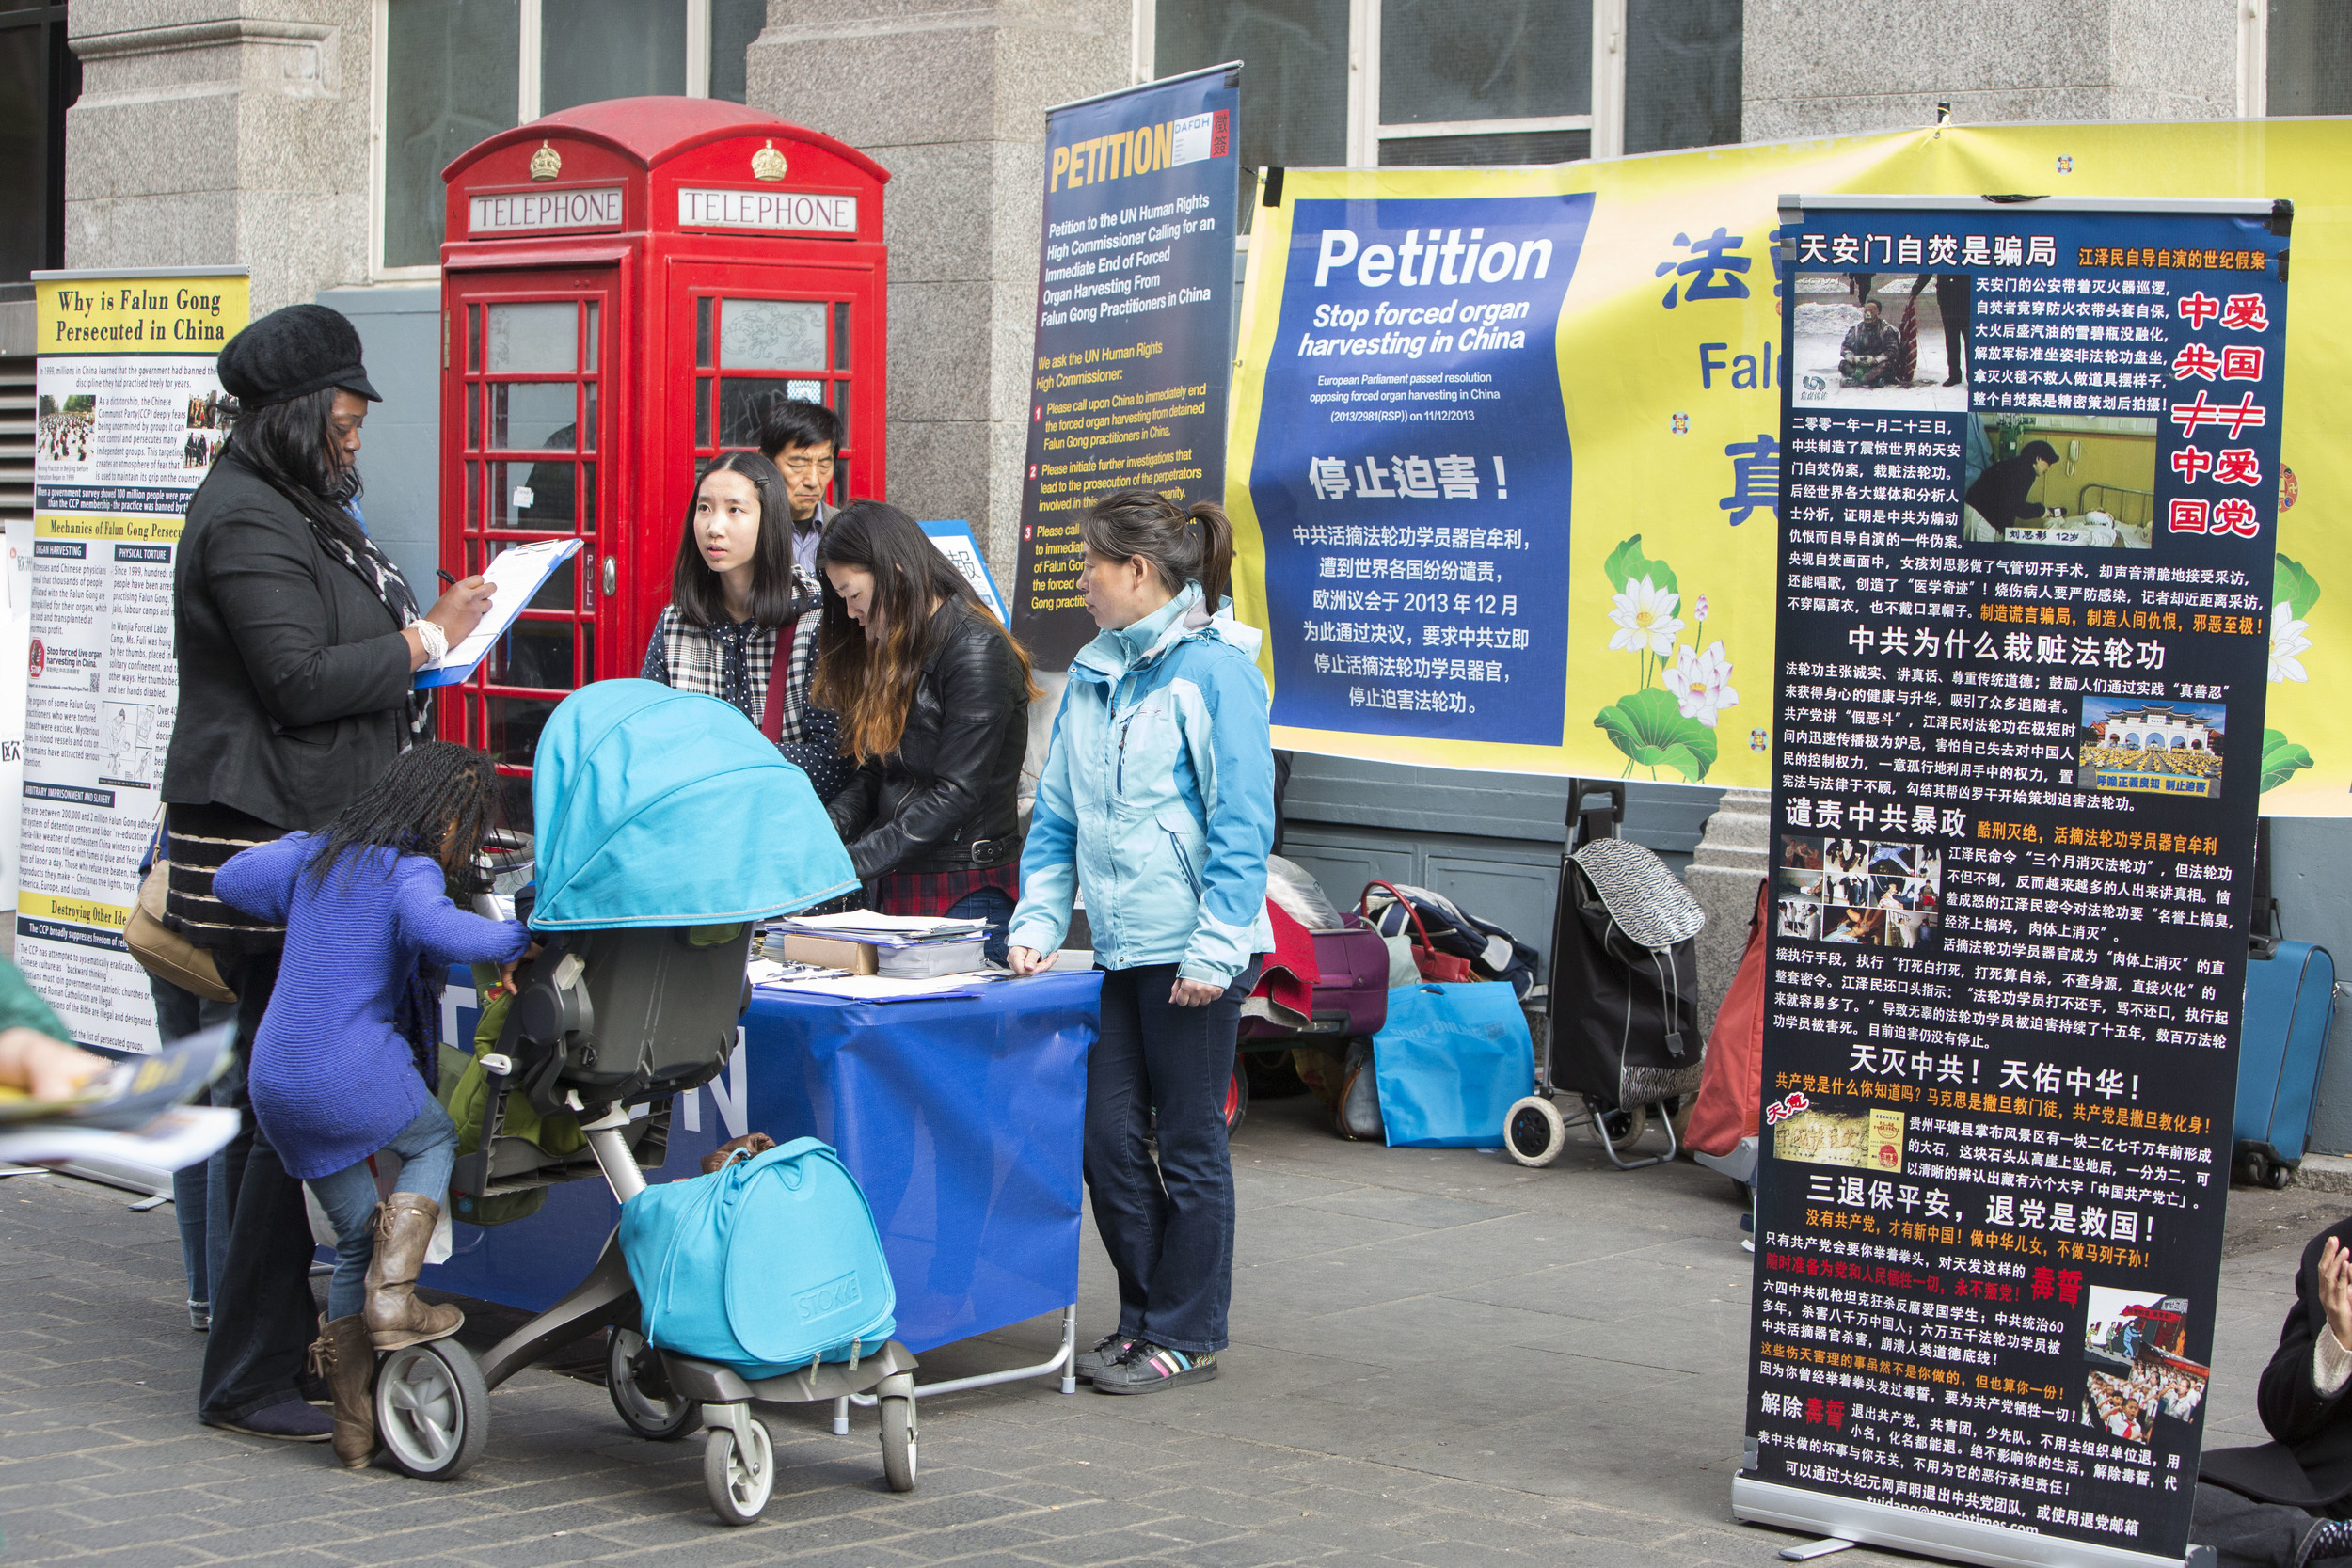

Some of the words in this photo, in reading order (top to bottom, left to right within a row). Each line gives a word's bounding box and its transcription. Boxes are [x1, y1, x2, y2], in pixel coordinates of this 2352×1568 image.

[1175, 117, 1209, 134] DAFOH
[1050, 121, 1173, 193] PETITION
[477, 192, 619, 227] TELEPHONE
[685, 191, 850, 228] TELEPHONE
[1049, 219, 1085, 238] Petition
[1087, 215, 1097, 230] to
[1100, 212, 1117, 227] the
[1120, 207, 1136, 224] UN
[1139, 202, 1174, 220] Human
[1176, 194, 1209, 214] Rights
[1047, 243, 1069, 261] High
[1071, 231, 1146, 255] Commissioner
[1148, 223, 1181, 242] Calling
[1182, 218, 1198, 234] for
[1200, 217, 1215, 230] an
[1800, 233, 2055, 266] 天安门自焚是骗局
[1045, 261, 1095, 282] Immediate
[1098, 255, 1120, 272] End
[1122, 252, 1134, 269] of
[1136, 245, 1170, 266] Forced
[1314, 228, 1553, 288] Petition
[2079, 248, 2266, 269] 江泽民自导自演的世纪假案
[57, 291, 93, 318] Why
[101, 291, 113, 310] is
[119, 289, 167, 309] Falun
[176, 288, 220, 316] Gong
[1043, 289, 1072, 306] Organ
[1074, 277, 1131, 299] Harvesting
[1134, 274, 1160, 290] From
[1041, 310, 1067, 326] Falun
[1069, 307, 1097, 322] Gong
[1100, 296, 1166, 317] Practitioners
[1168, 291, 1176, 307] in
[1178, 286, 1211, 304] China
[1313, 304, 1369, 331] Stop
[1374, 299, 1458, 325] forced
[1459, 301, 1530, 328] organ
[56, 319, 143, 341] Persecuted
[150, 319, 165, 339] in
[173, 318, 224, 340] China
[1298, 331, 1427, 358] harvesting
[1429, 329, 1454, 352] in
[1458, 328, 1525, 351] China
[1038, 356, 1050, 370] We
[1052, 354, 1067, 368] ask
[1069, 352, 1082, 365] the
[1084, 348, 1099, 363] UN
[1102, 347, 1135, 361] Human
[1136, 341, 1162, 356] Rights
[1036, 375, 1054, 392] High
[1056, 369, 1122, 387] Commissioner:
[1317, 375, 1359, 387] European
[1361, 373, 1408, 384] Parliament
[1409, 372, 1443, 385] passed
[1444, 372, 1491, 382] resolution
[1036, 408, 1041, 420] 1
[1046, 403, 1072, 414] Please
[1073, 398, 1087, 411] call
[1089, 399, 1110, 411] upon
[1111, 394, 1135, 407] China
[1136, 392, 1144, 404] to
[1145, 385, 1186, 403] immediately
[1187, 382, 1206, 396] end
[1310, 390, 1349, 404] opposing
[1351, 389, 1379, 401] forced
[1380, 392, 1406, 403] organ
[1408, 389, 1457, 402] harvesting
[1459, 389, 1469, 399] in
[1470, 388, 1500, 399] China
[1045, 420, 1057, 432] the
[1058, 417, 1084, 430] forced
[1085, 417, 1110, 429] organ
[1111, 410, 1151, 425] harvesting
[1152, 407, 1168, 420] from
[1168, 401, 1205, 417] detained
[1330, 410, 1407, 422] (2013/2981(RSP))
[1423, 410, 1474, 420] 11/12/2013
[1792, 417, 1951, 435] 二零零一年一月二十三日，
[1043, 437, 1065, 450] Falun
[1066, 435, 1089, 449] Gong
[1089, 431, 1140, 448] practitioners
[1141, 428, 1148, 439] in
[1149, 425, 1170, 438] China.
[1792, 438, 1960, 457] 中共制造了震惊世界的天安
[1309, 454, 1507, 499] 停止迫害！
[1790, 484, 1959, 502] 后经世界各大媒体和分析人
[51, 519, 92, 534] Mechanics
[96, 521, 103, 534] of
[105, 522, 123, 535] Falun
[127, 523, 149, 541] Gong
[1293, 525, 1529, 550] 中共活摘法轮功学员器官牟利，
[1789, 530, 1962, 548] 仇恨而自导自演的一件伪案。
[119, 548, 142, 558] PHYSICAL
[144, 549, 166, 560] TORTURE
[1319, 557, 1501, 582] 遭到世界各国纷纷谴责，
[1312, 590, 1399, 611] 欧洲议会于
[1404, 593, 1448, 613] 2013
[1454, 594, 1470, 615] 年
[1476, 595, 1496, 614] 12
[1502, 596, 1518, 616] 月
[1303, 622, 1529, 650] 为此通过决议，要求中共立即
[1849, 625, 2164, 670] 中共为什么栽赃法轮功
[1314, 653, 1508, 682] 停止活摘法轮功学员器官，
[1349, 687, 1475, 713] 停止迫害法轮功。
[1786, 797, 1965, 838] 谴责中共暴政
[51, 900, 90, 924] Destroying
[93, 907, 111, 923] Other
[798, 1277, 858, 1318] STOKKE
